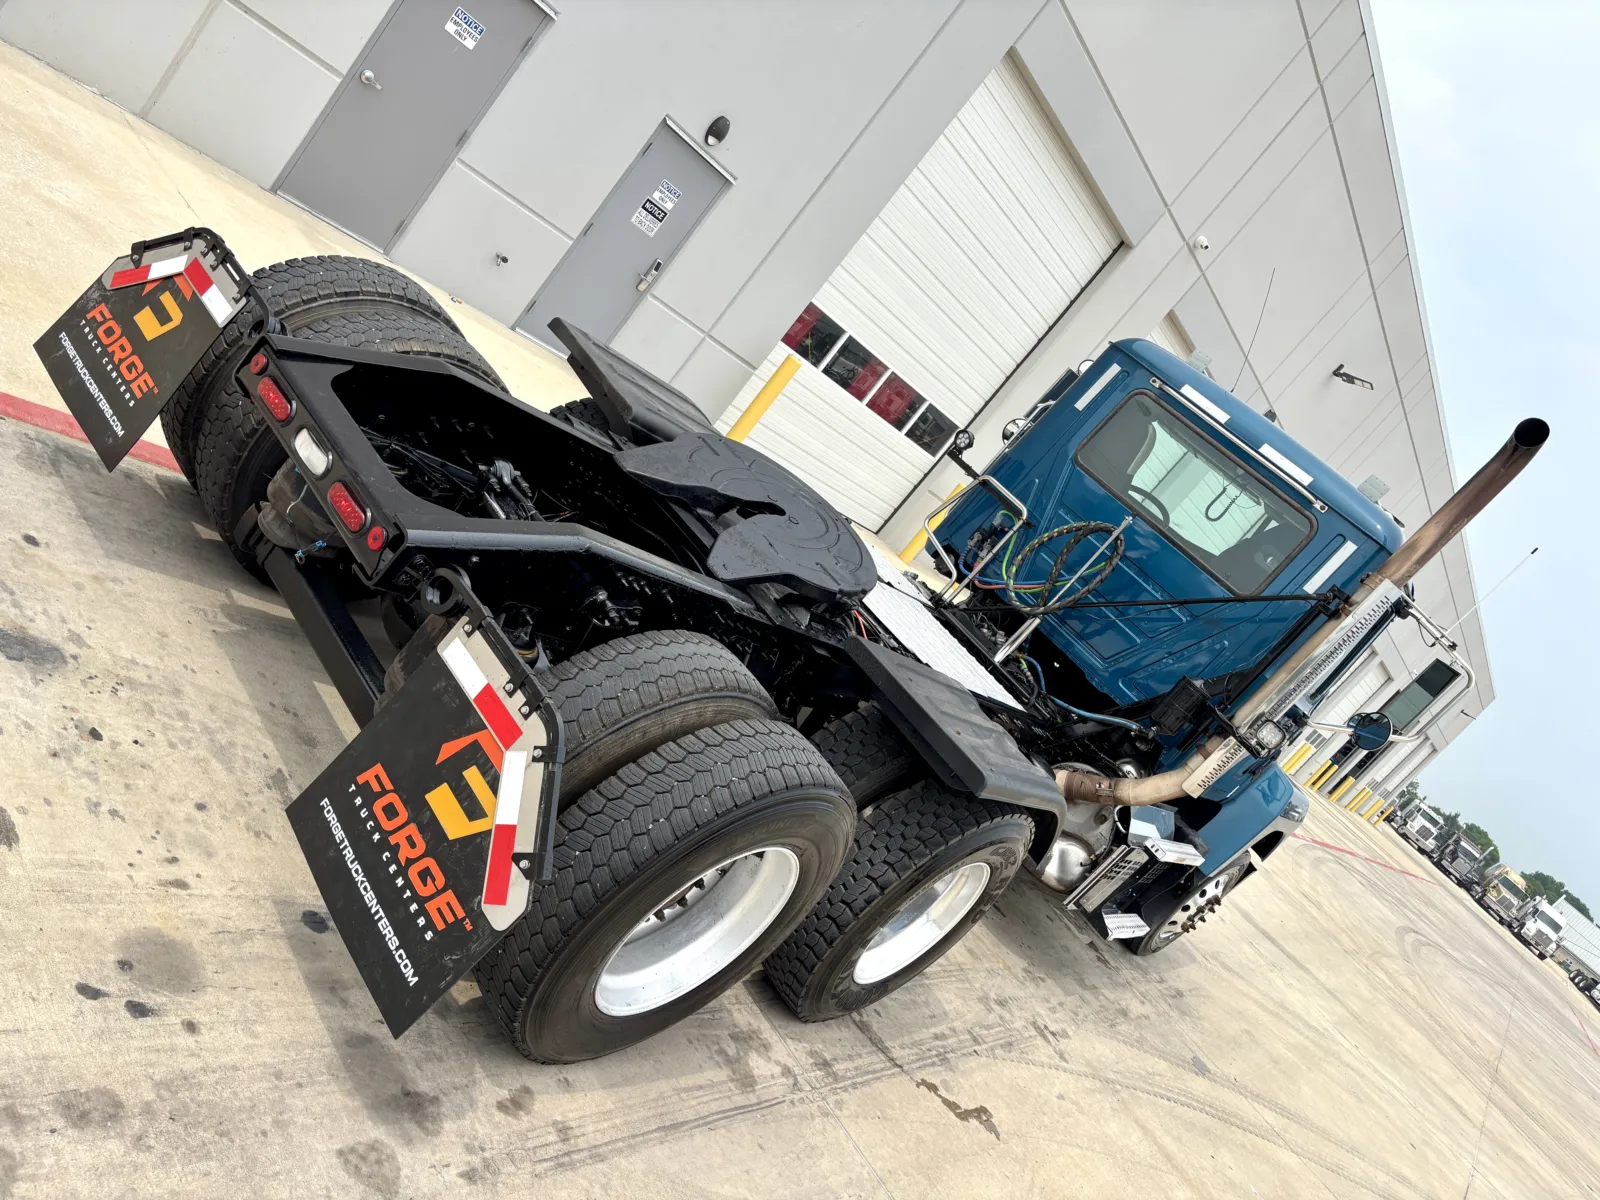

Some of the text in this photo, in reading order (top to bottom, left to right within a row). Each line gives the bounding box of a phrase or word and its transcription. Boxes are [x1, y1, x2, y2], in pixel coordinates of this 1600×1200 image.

[450, 17, 478, 42] EMPLOYEES
[456, 10, 484, 35] NOTICE
[454, 29, 467, 42] ONLY
[657, 187, 676, 204] EMPLOYEES
[659, 196, 668, 204] ONLY
[662, 182, 681, 199] NOTICE
[644, 201, 665, 220] NOTICE
[80, 319, 135, 407] TRUCK CENTERS
[86, 302, 155, 399] FORGE
[58, 331, 125, 438] FORGETRUCKCENTERS.COM
[356, 763, 465, 931] FORGE
[348, 783, 434, 942] TRUCK CENTERS
[319, 796, 419, 987] FORGETRUCKCENTERS.COM
